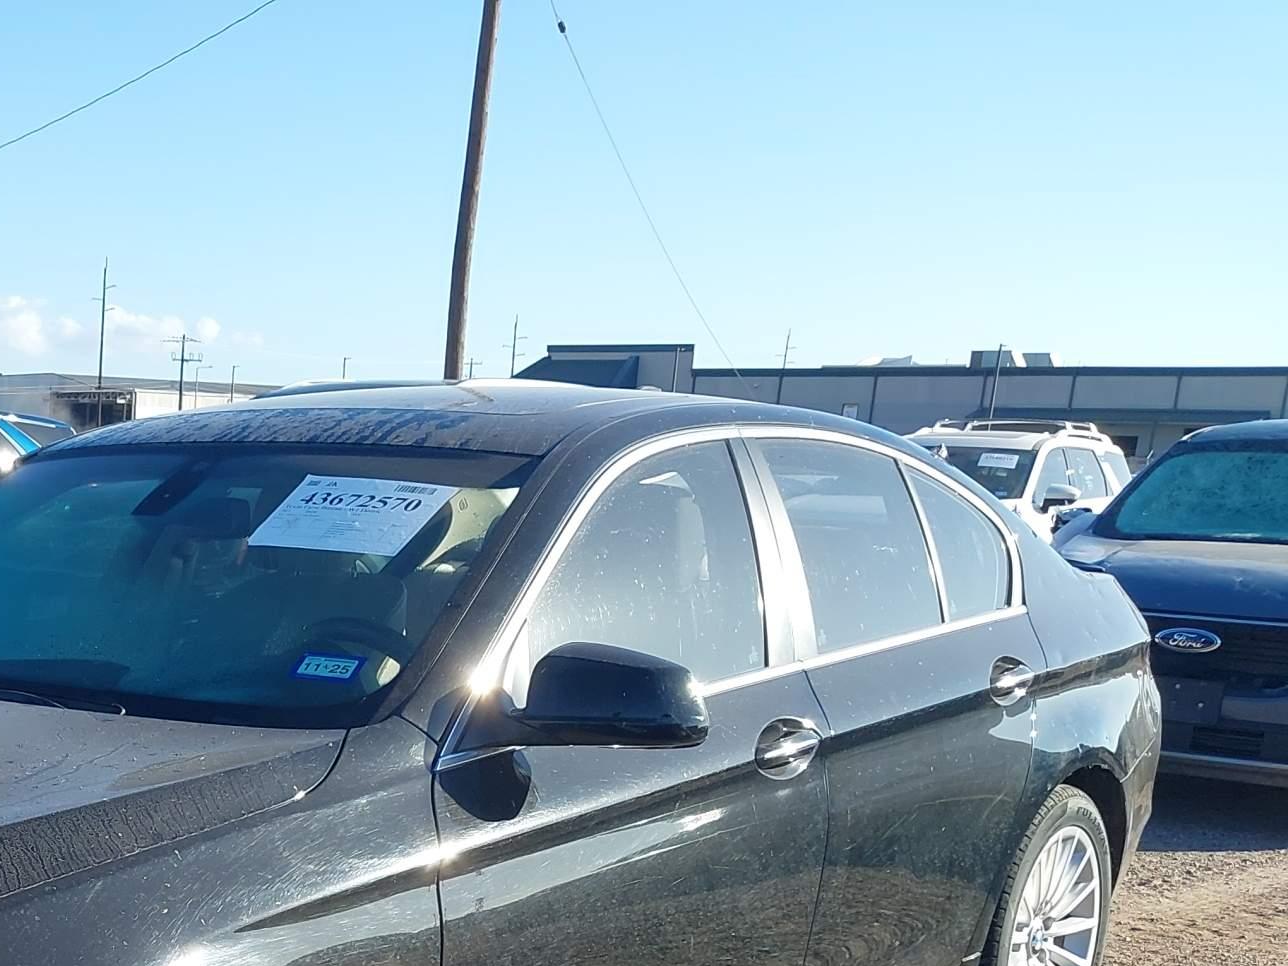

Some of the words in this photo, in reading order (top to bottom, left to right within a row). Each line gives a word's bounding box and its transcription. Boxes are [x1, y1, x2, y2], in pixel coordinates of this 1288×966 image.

[300, 491, 423, 512] 43672570
[1169, 632, 1206, 648] Ford
[303, 662, 322, 672] 11
[328, 663, 352, 675] 25
